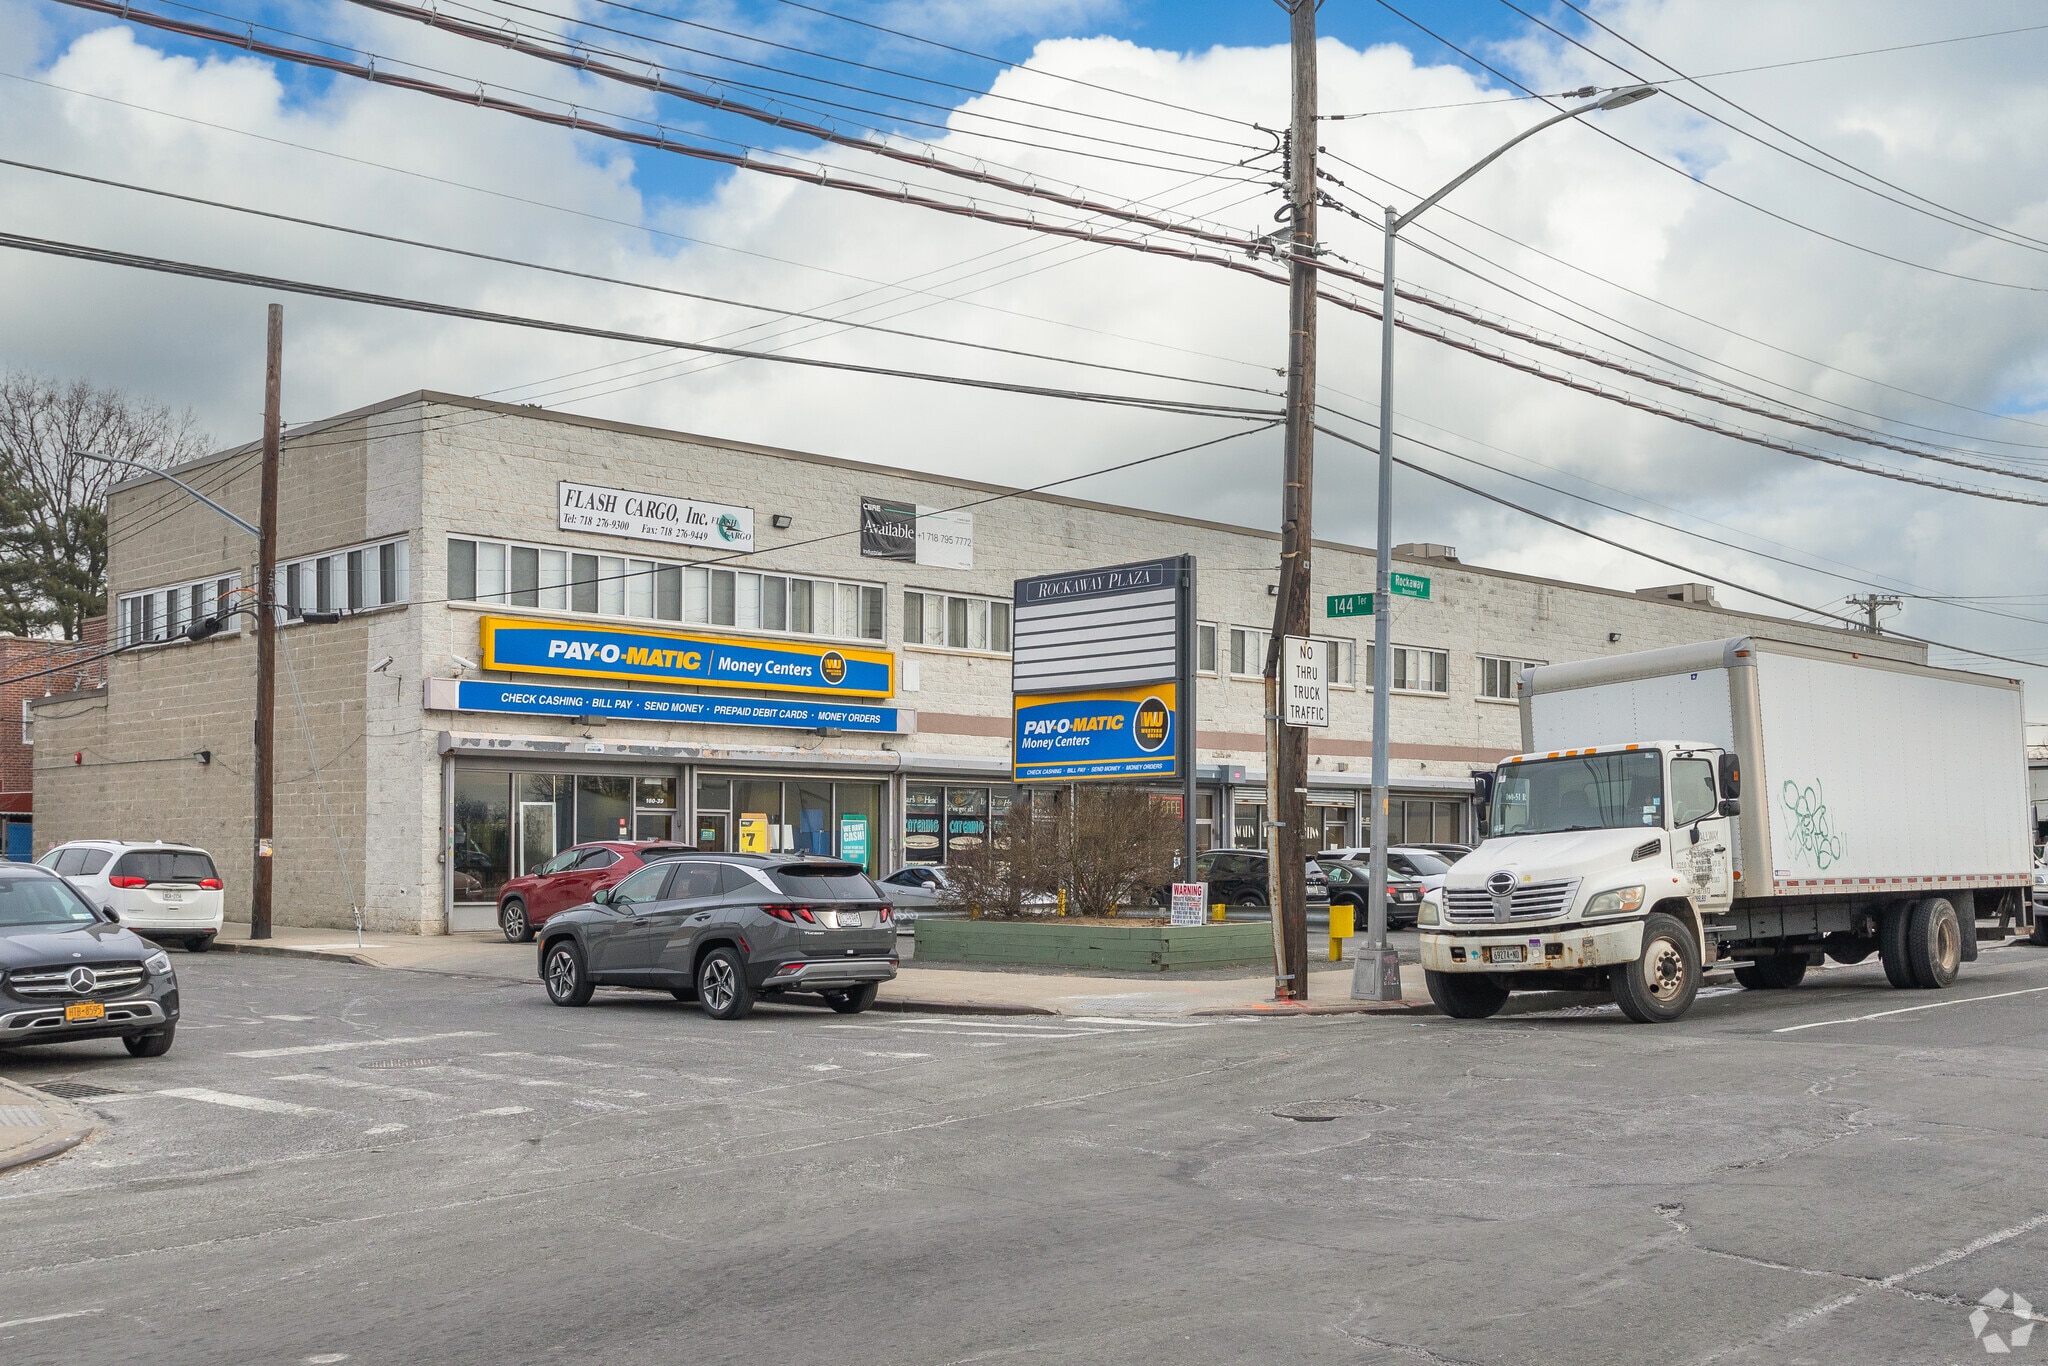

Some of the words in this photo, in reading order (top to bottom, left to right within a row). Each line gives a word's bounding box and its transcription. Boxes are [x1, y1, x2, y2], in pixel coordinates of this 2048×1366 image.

[564, 488, 617, 513] FLASH
[625, 497, 679, 525] CARGO,
[686, 506, 708, 526] Inc.
[863, 503, 881, 512] CBRE
[563, 513, 576, 524] Tel:
[579, 515, 592, 526] 718
[596, 517, 629, 531] 276-9300
[641, 524, 658, 535] Fax:
[660, 526, 672, 537] 718
[676, 528, 708, 541] 276-9449
[711, 517, 737, 527] FLASH
[863, 519, 914, 540] Available
[724, 531, 751, 541] CARGO
[917, 532, 924, 541] +1
[927, 533, 938, 543] 718
[941, 534, 953, 545] 795
[955, 536, 971, 547] 7772
[1038, 575, 1104, 598] ROCKAWAY
[1108, 569, 1150, 589] PLAZA
[1395, 574, 1425, 592] Rockaway
[1334, 597, 1354, 615] 144
[1358, 595, 1367, 605] Ter
[1300, 645, 1313, 660] NO
[718, 656, 763, 677] Money
[765, 660, 812, 677] Centers
[1296, 665, 1317, 681] THRU
[1293, 685, 1320, 700] TRUCK
[501, 692, 537, 704] CHECK
[539, 695, 583, 707] CASHING
[592, 698, 613, 708] BILL
[614, 699, 633, 709] PAY
[644, 701, 669, 712] SEND
[671, 702, 704, 713] MONEY
[713, 705, 751, 716] PREPAID
[752, 707, 778, 718] DEBIT
[779, 709, 808, 720] CARDS
[817, 711, 847, 722] MONEY
[848, 714, 881, 724] ORDERS
[1290, 704, 1324, 721] TRAFFIC
[1140, 711, 1164, 727] WU
[1022, 737, 1052, 750] Money
[1055, 735, 1090, 748] Centers
[851, 823, 864, 832] HAVE
[949, 820, 984, 834] CATERING
[843, 830, 865, 842] CASH!
[1174, 884, 1202, 896] WARNING
